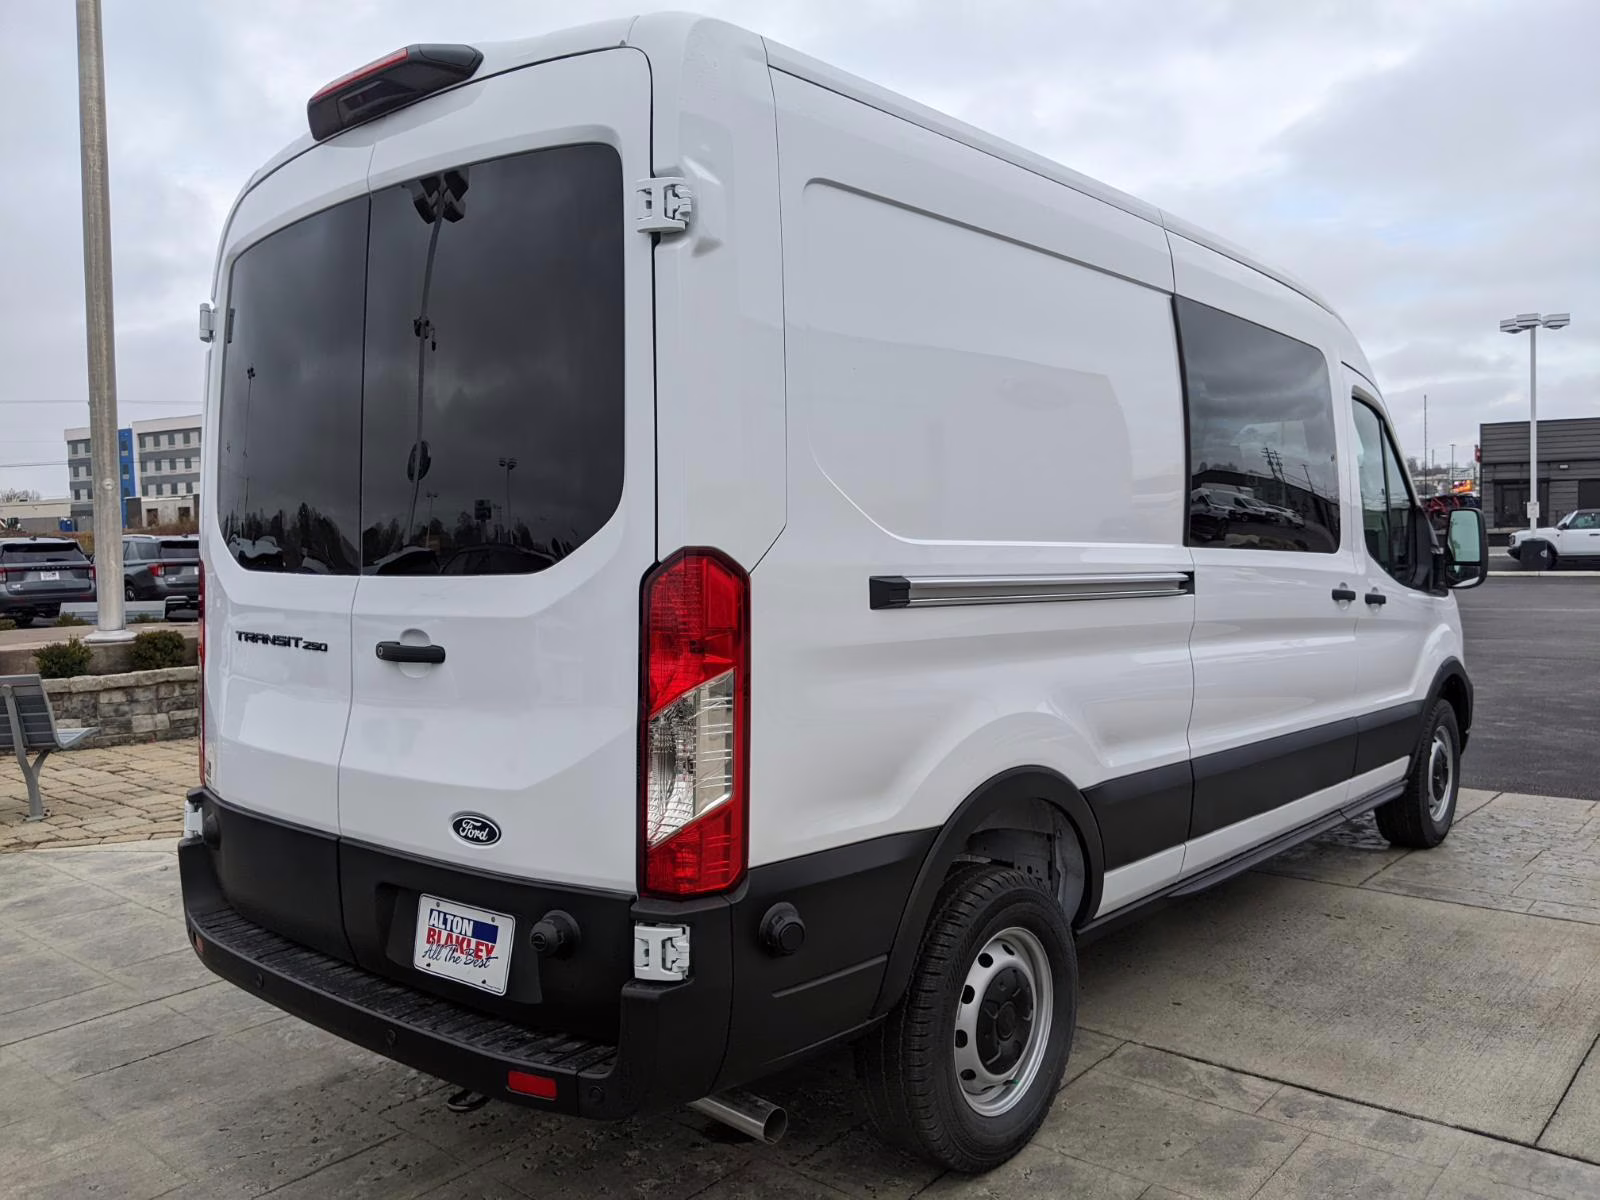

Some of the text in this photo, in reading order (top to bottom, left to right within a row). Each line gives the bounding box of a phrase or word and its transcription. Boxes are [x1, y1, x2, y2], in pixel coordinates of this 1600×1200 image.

[235, 630, 328, 652] TRANSIT 250
[459, 819, 489, 841] Ford
[429, 910, 473, 937] ALTON
[422, 942, 498, 968] All The Best
[426, 927, 495, 960] BLAKLEY
